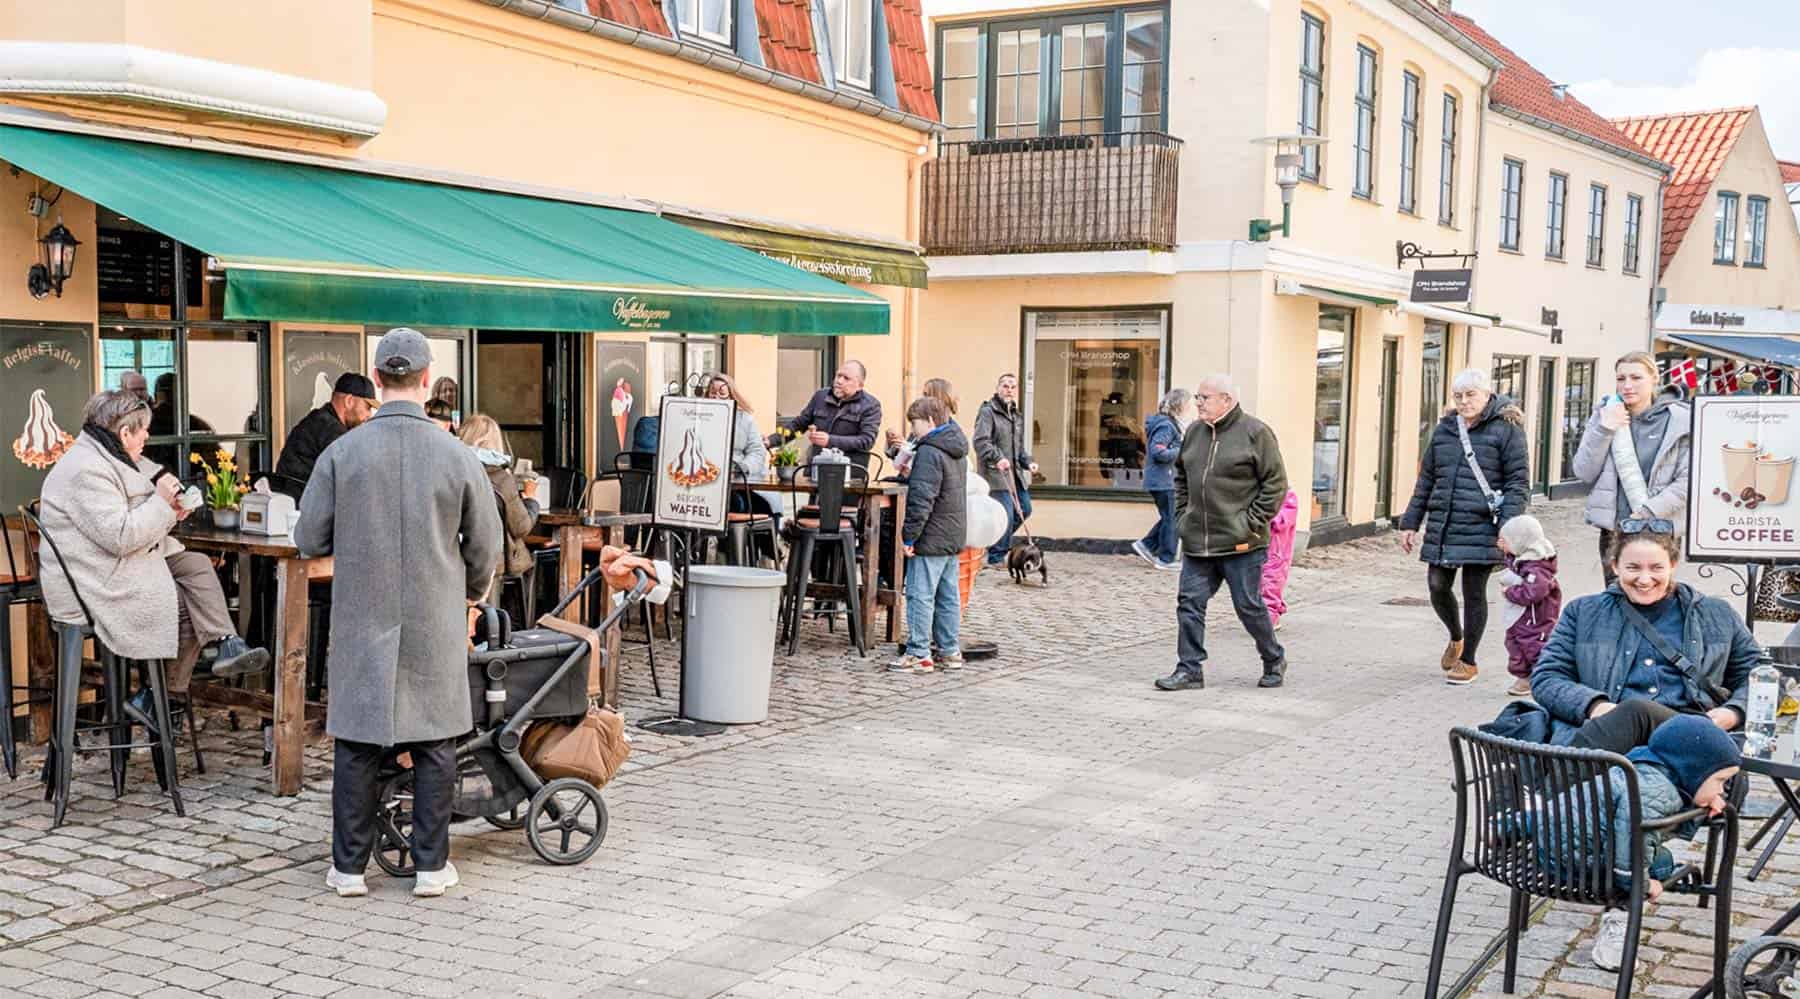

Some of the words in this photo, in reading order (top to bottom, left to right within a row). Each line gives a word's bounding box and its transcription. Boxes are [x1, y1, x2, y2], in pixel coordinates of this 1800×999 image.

[670, 503, 712, 518] WAFFEL
[1728, 516, 1782, 526] BARISTA
[1716, 528, 1795, 543] COFFEE
